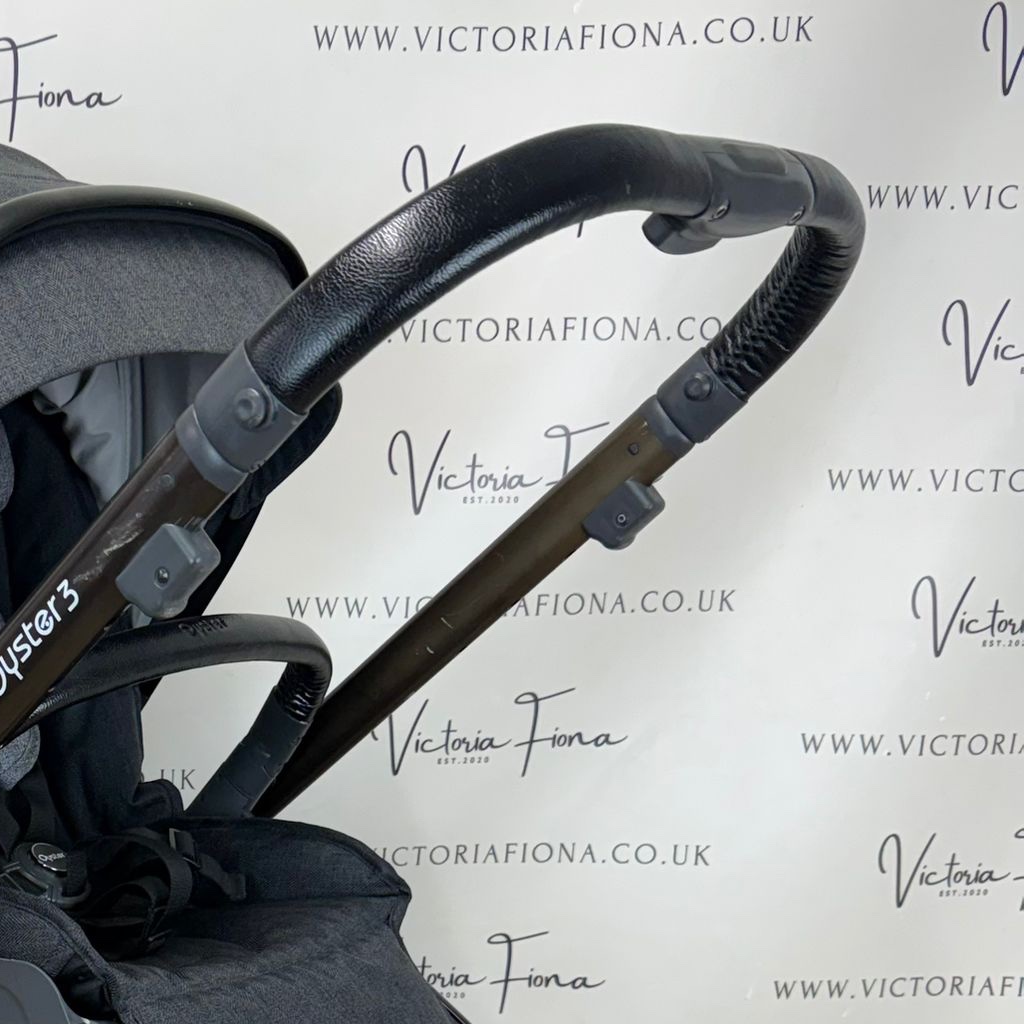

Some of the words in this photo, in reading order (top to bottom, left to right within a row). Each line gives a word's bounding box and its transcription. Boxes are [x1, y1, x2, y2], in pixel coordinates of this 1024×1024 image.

[313, 16, 813, 52] WWW.VICTORIAFIONA.CO.UK
[388, 429, 543, 516] Victoria
[463, 496, 519, 504] EST.2020
[371, 699, 512, 776] Victoria
[514, 688, 628, 778] Fiona
[801, 733, 1024, 757] WWW.VICTORI
[437, 756, 489, 765] EST.2020
[878, 833, 1010, 908] Victoria
[939, 889, 988, 897] EST.2020
[487, 931, 606, 1015] Fiona
